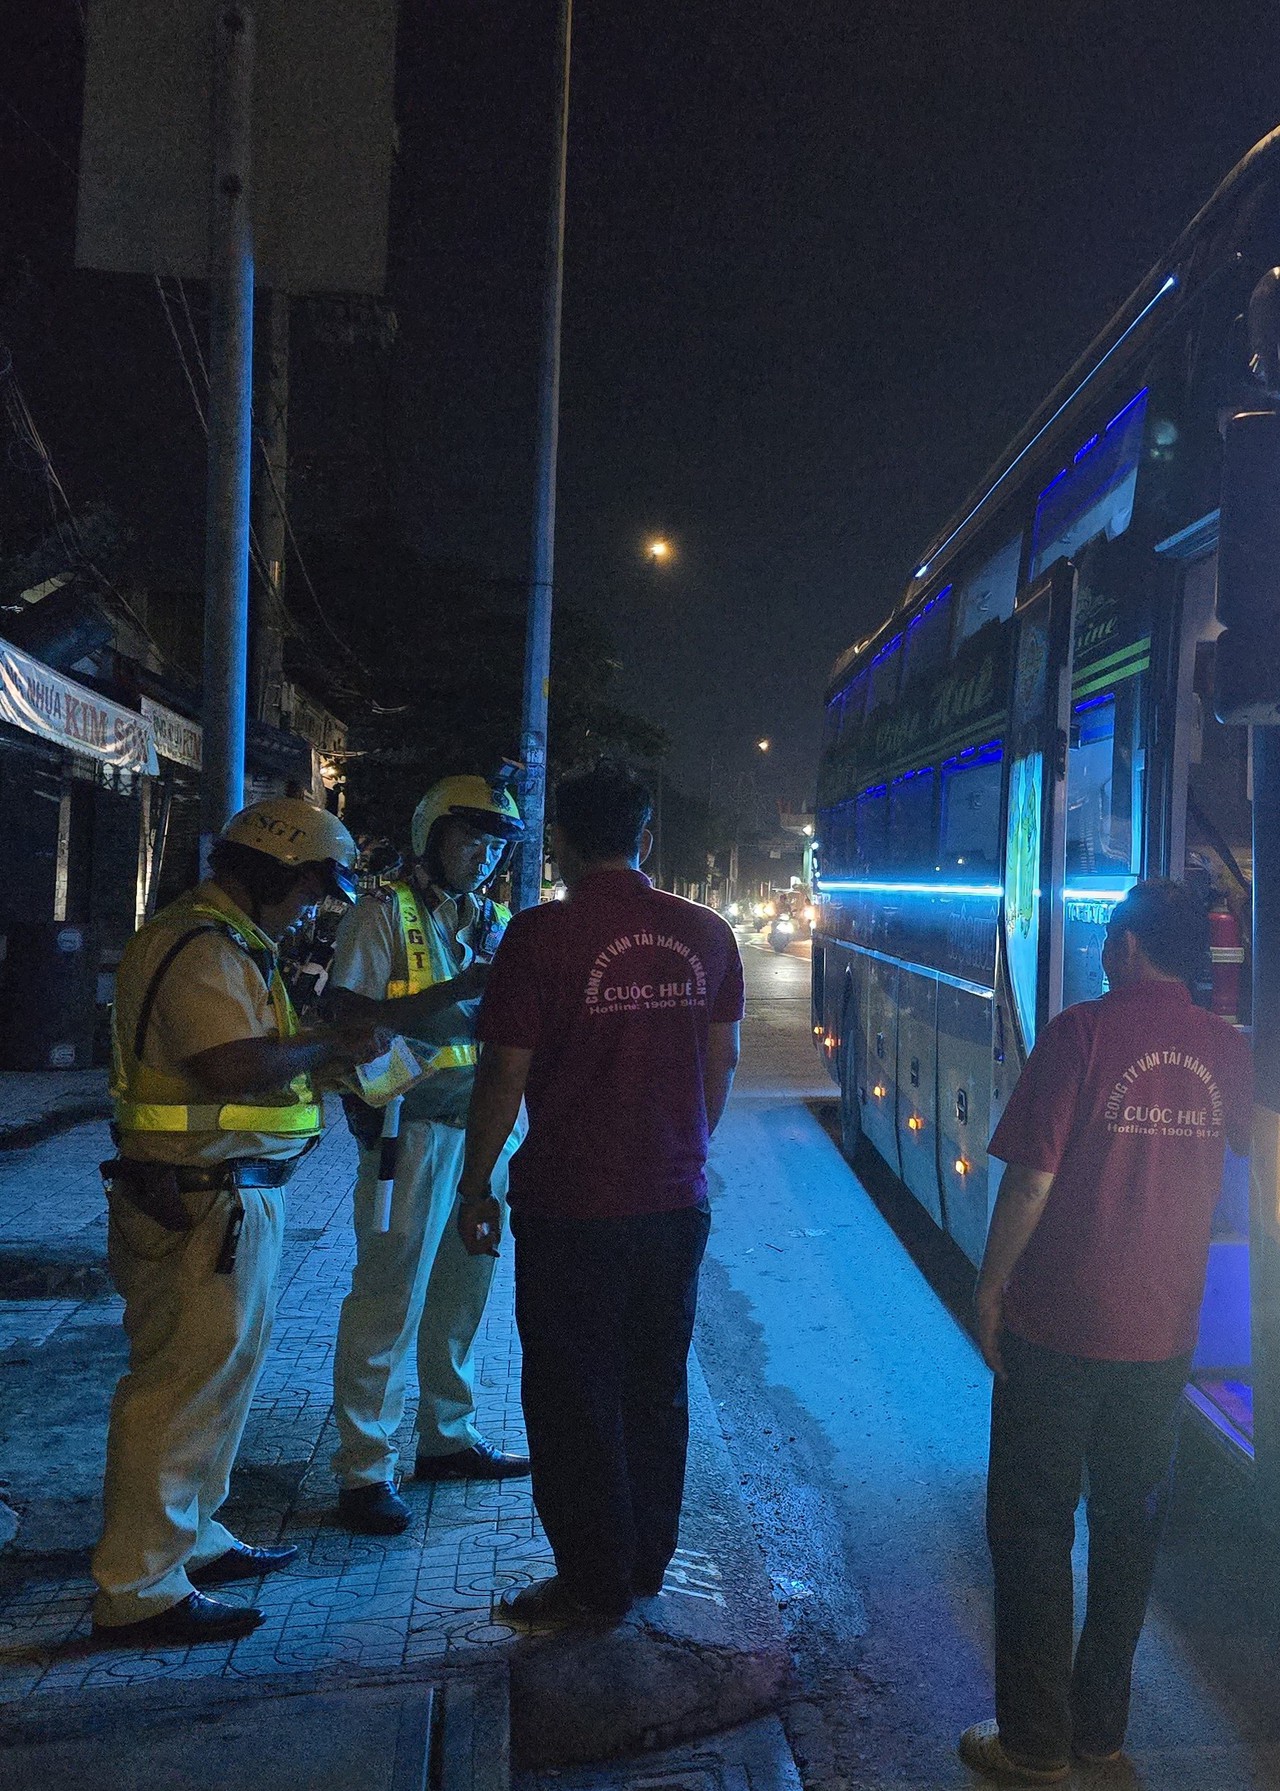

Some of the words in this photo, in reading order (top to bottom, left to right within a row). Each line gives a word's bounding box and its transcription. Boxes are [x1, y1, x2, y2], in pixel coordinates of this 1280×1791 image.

[64, 692, 107, 748] KIM
[595, 952, 611, 968] TY
[604, 981, 655, 1003] CUỘC
[644, 1000, 676, 1009] 1900
[1122, 1065, 1139, 1083] TY
[1136, 1052, 1160, 1072] VẬN
[1162, 1046, 1181, 1065] TẢI
[1123, 1103, 1173, 1128] CUỘC
[1161, 1127, 1193, 1137] 1900
